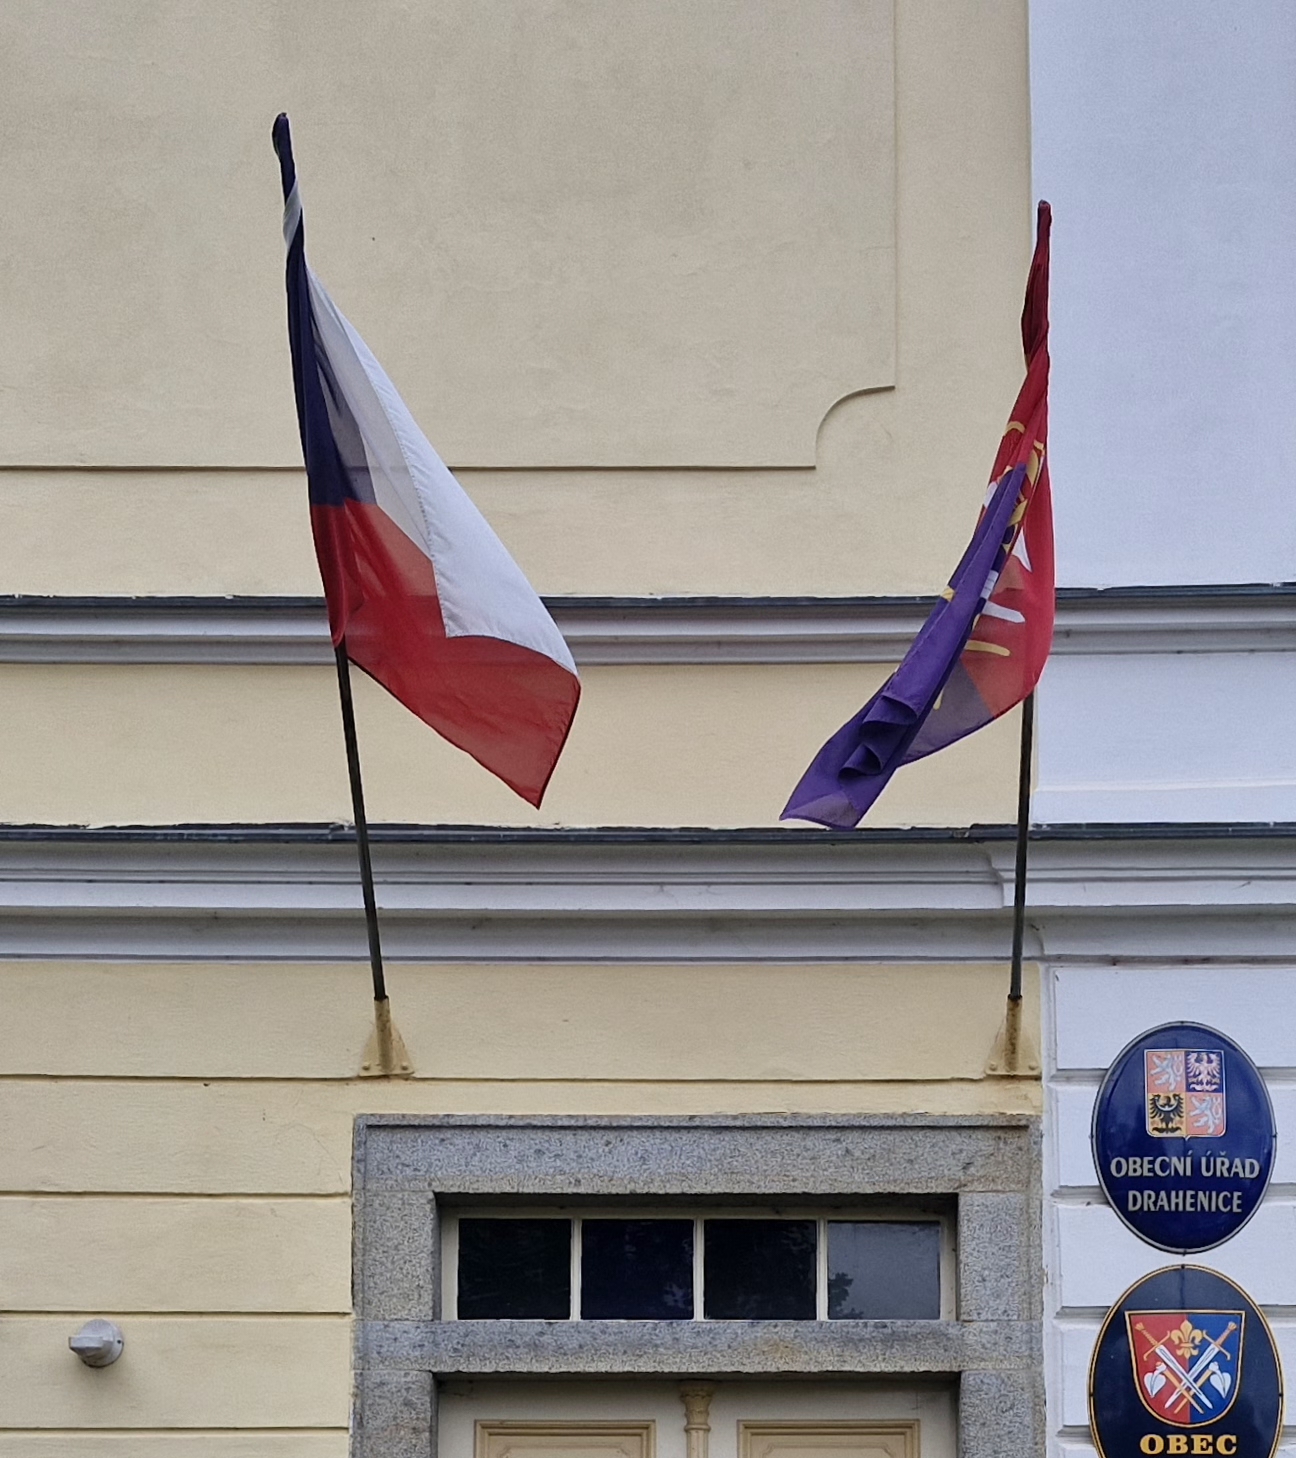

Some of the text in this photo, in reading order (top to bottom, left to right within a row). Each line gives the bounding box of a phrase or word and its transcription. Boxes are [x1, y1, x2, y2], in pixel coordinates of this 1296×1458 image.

[1110, 1149, 1260, 1180] OBECNÍ ÚŘAD
[1127, 1190, 1243, 1214] DRAHENICE
[1139, 1433, 1239, 1455] OBEC
